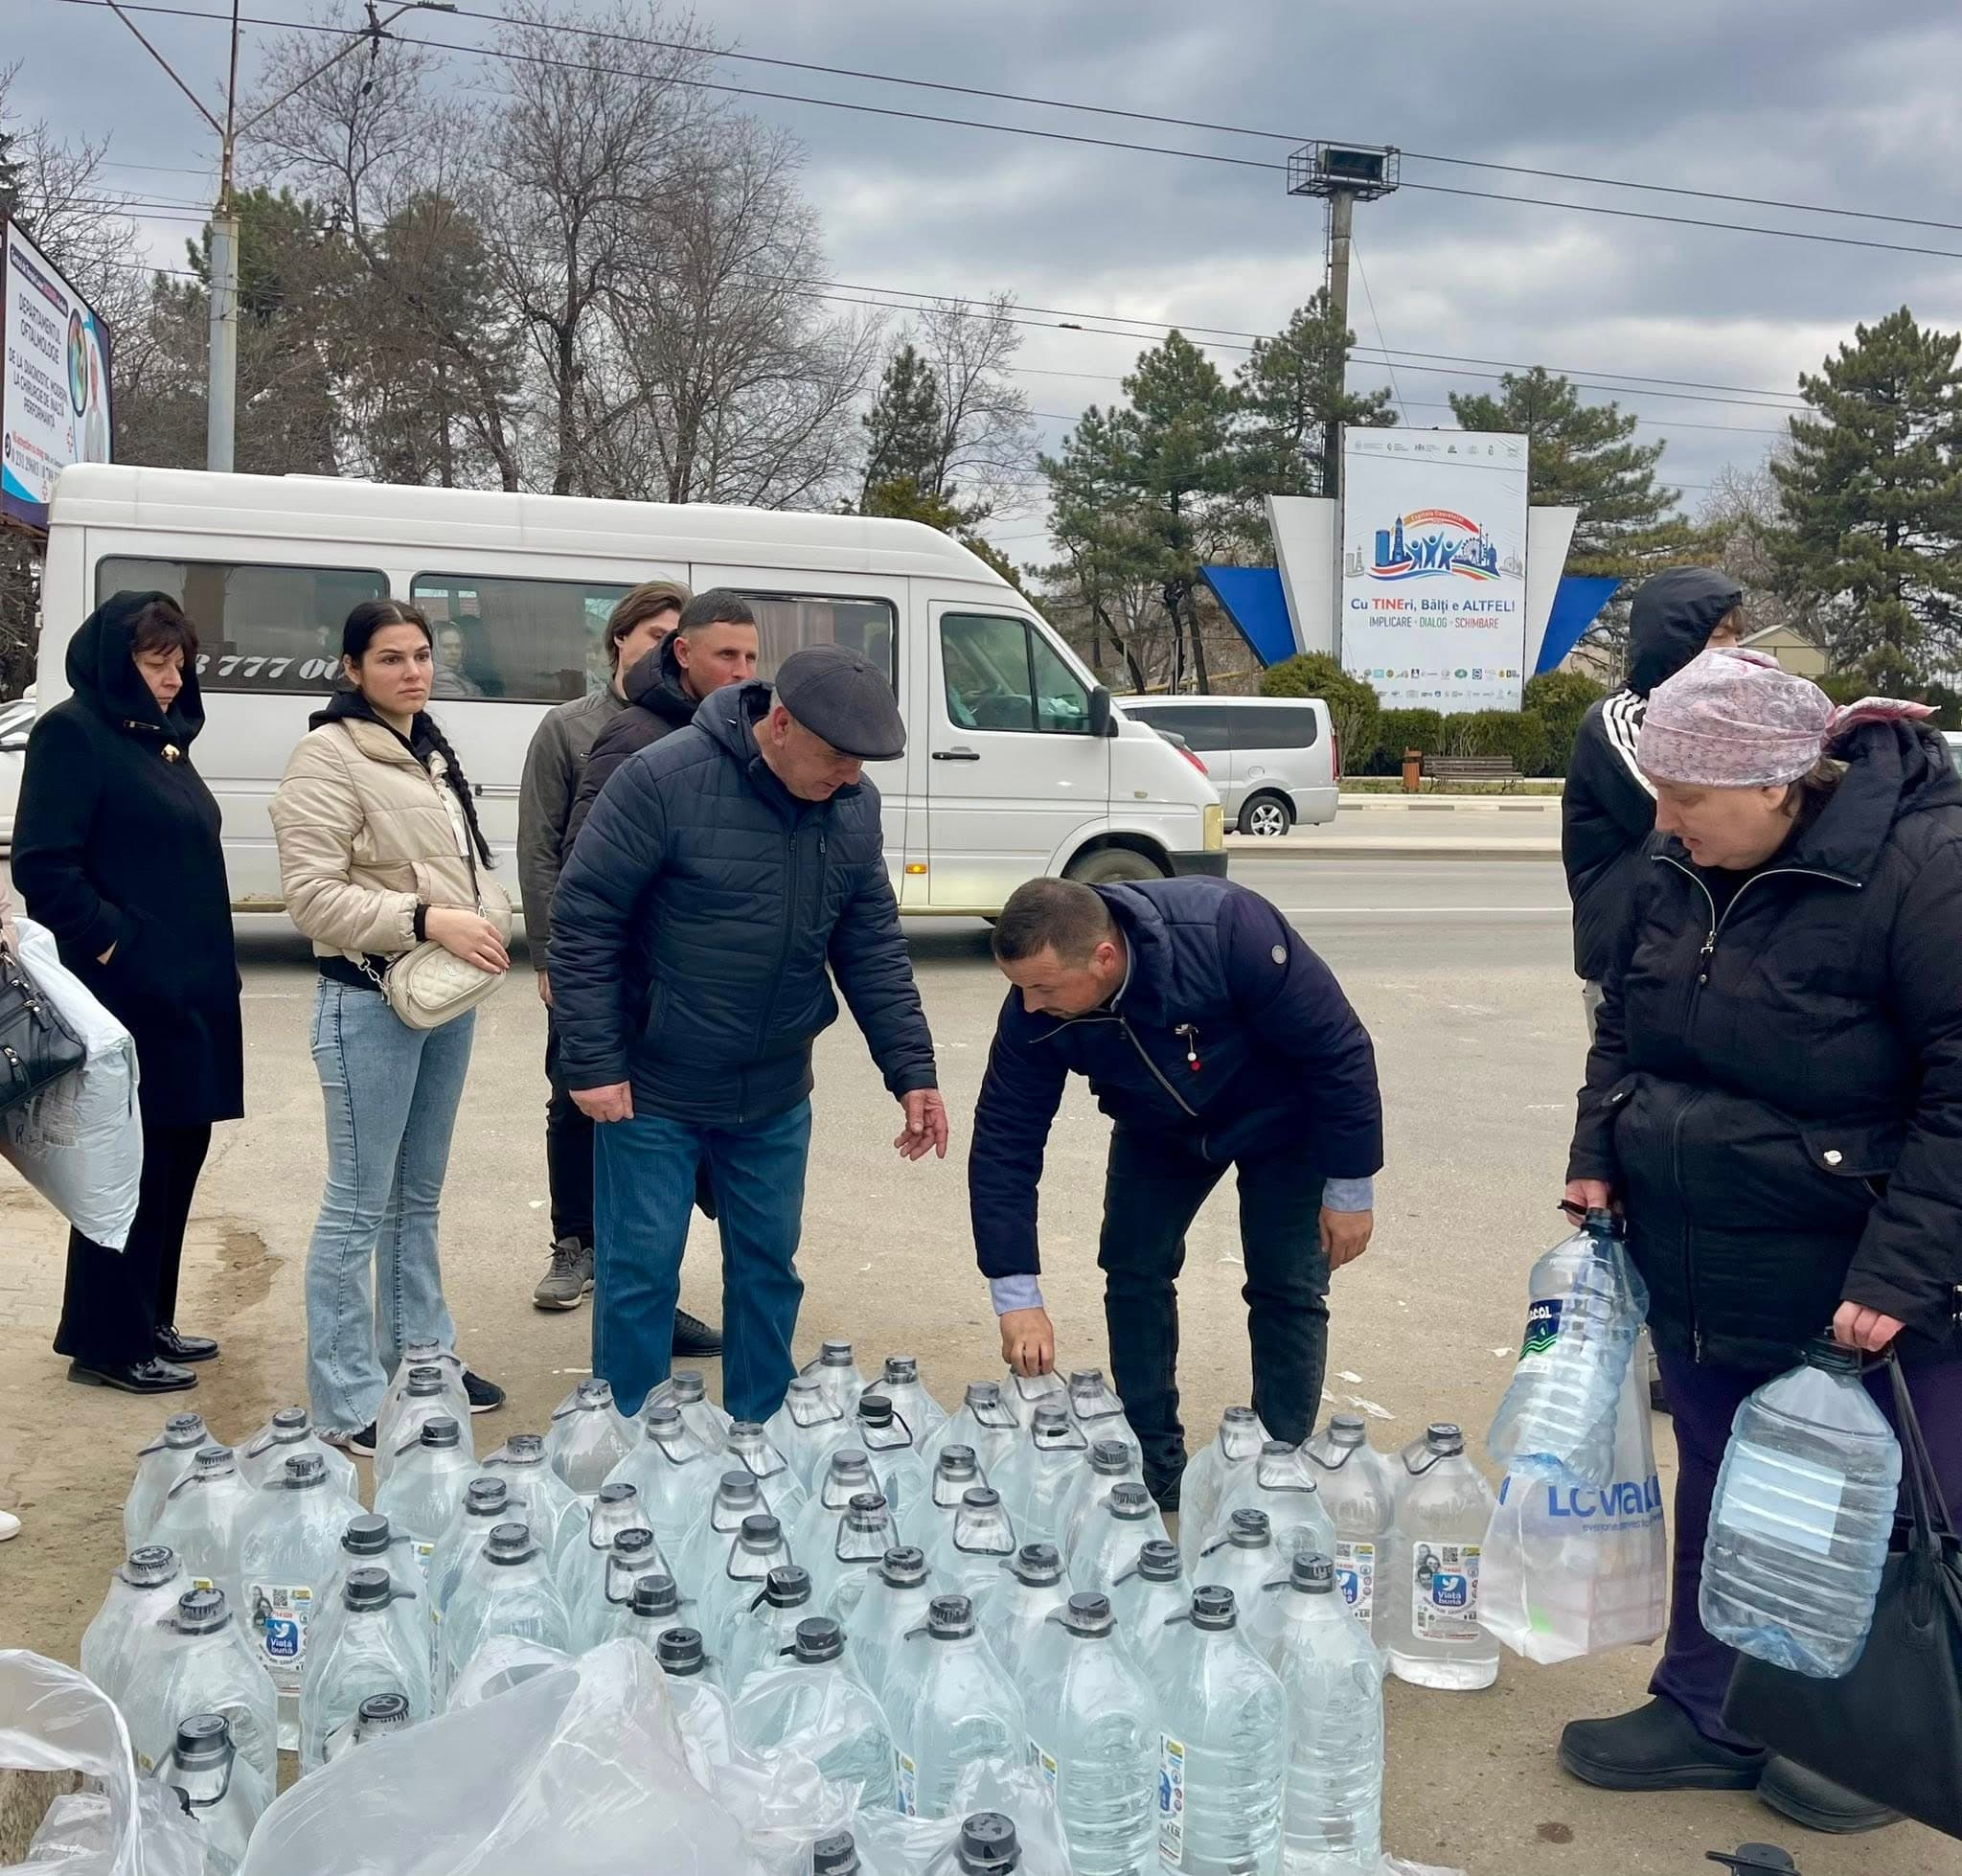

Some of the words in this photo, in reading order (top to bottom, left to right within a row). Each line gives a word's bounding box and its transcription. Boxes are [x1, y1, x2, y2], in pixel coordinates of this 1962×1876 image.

[1351, 598, 1368, 610] Cu
[1372, 598, 1417, 612] TINEri,
[1451, 603, 1459, 611] e
[1463, 599, 1516, 613] ALTFEL!
[1369, 616, 1412, 629] IMPLICARE
[1419, 616, 1448, 629] DIALOG
[1454, 617, 1500, 629] SCHIMBARE
[217, 654, 297, 678] 777
[1548, 1485, 1597, 1518] LC
